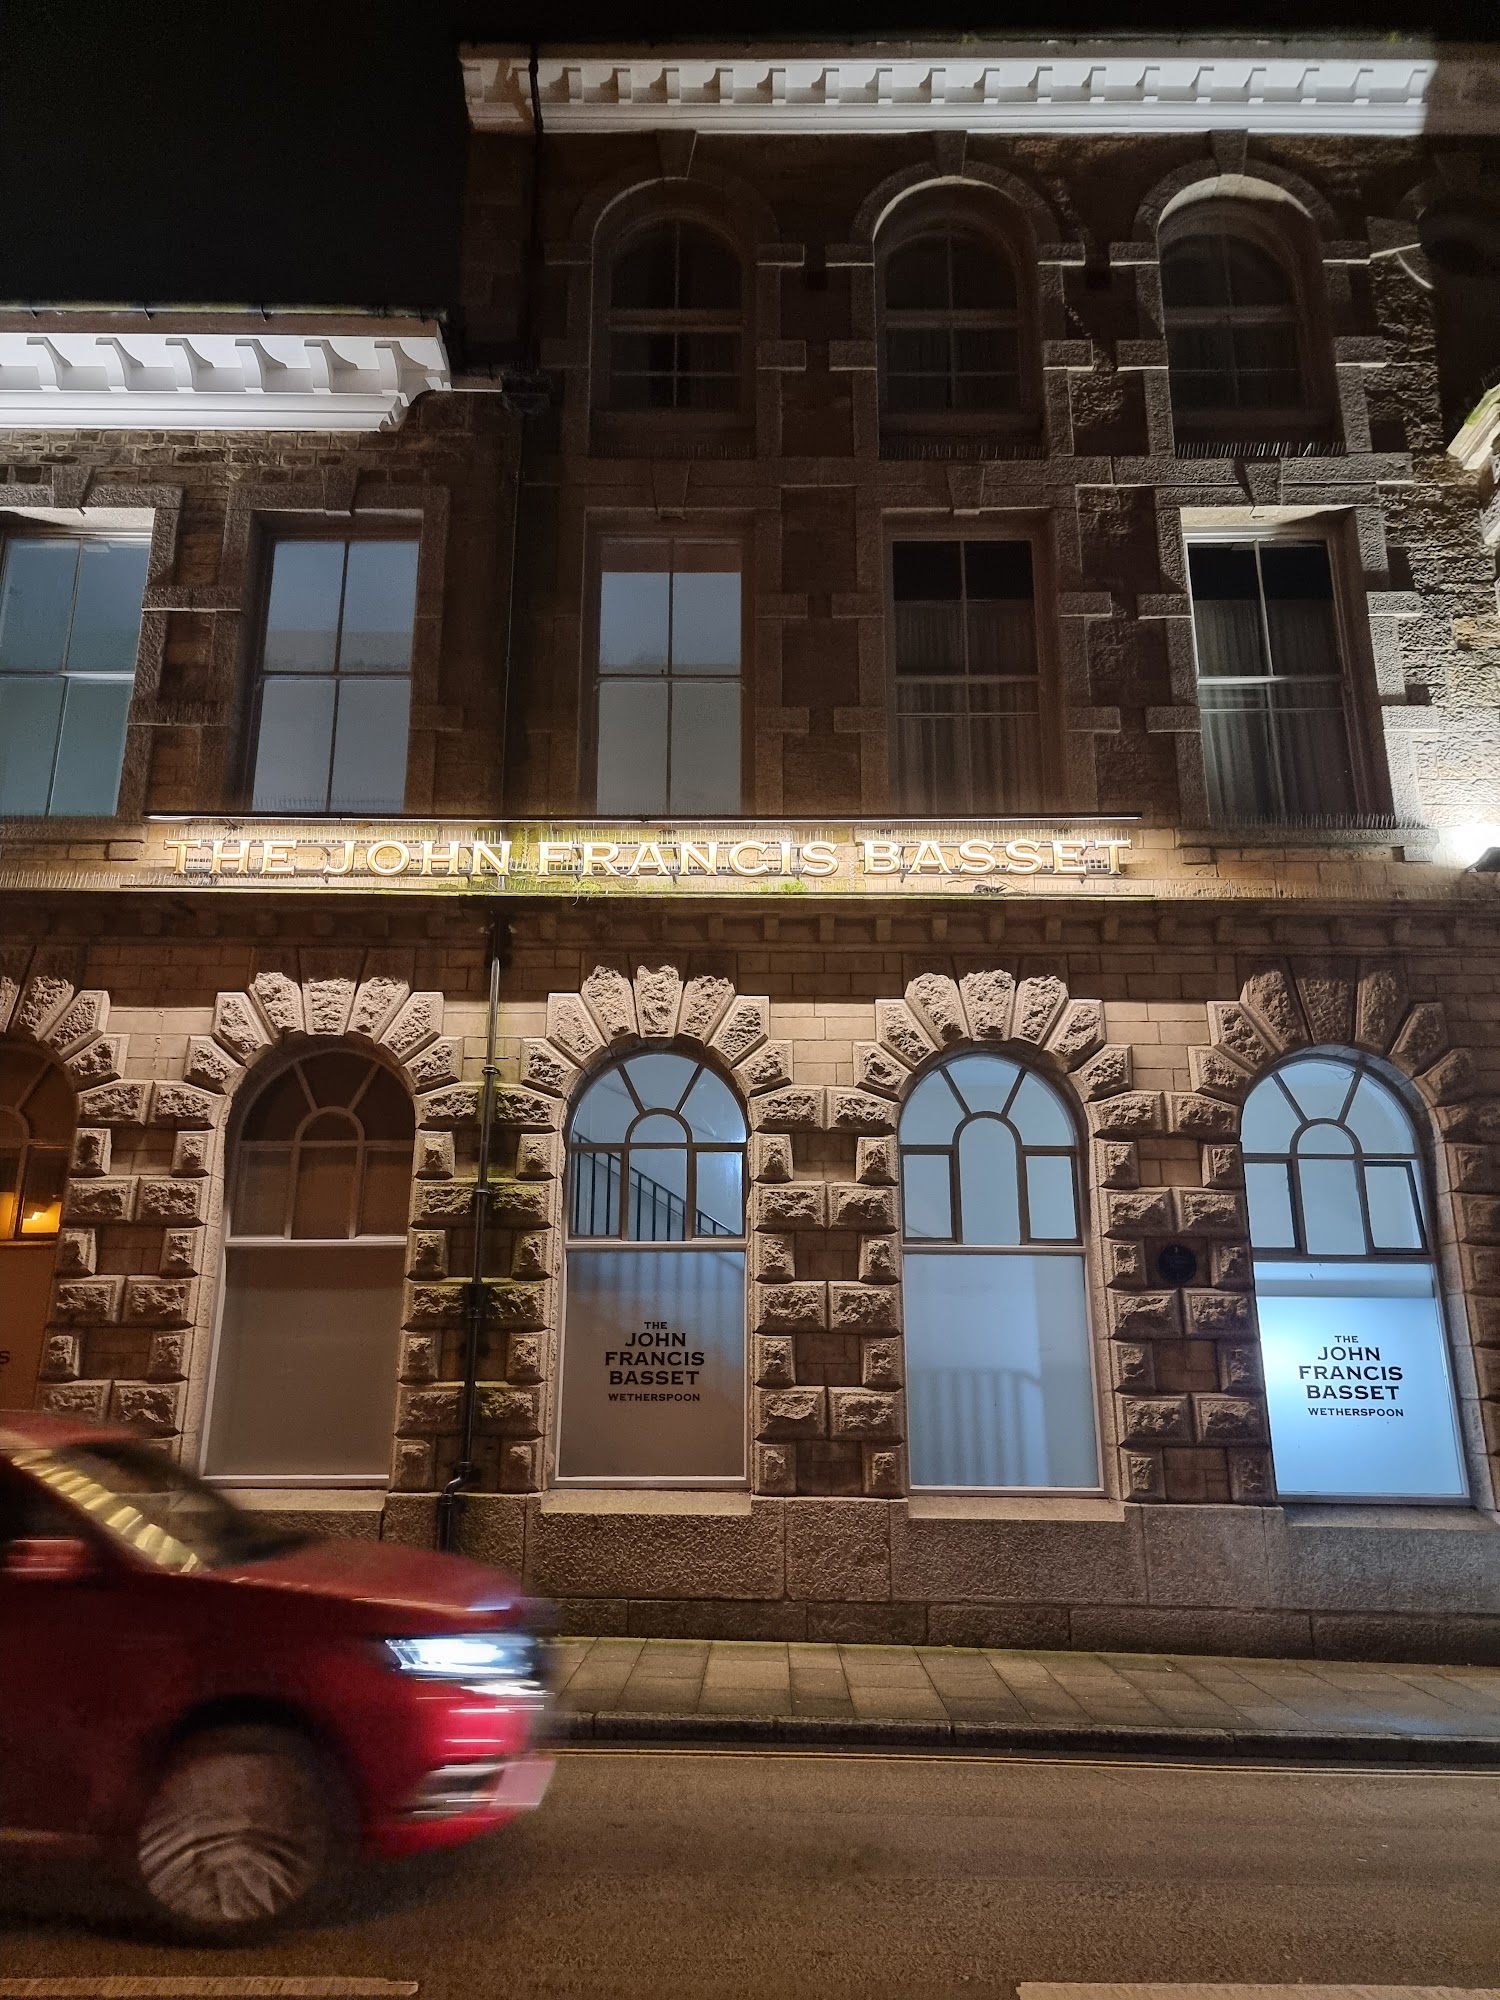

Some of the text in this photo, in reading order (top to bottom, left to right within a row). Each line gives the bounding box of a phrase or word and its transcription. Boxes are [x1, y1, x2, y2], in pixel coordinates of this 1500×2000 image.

[163, 838, 1132, 876] THE JOHN FRANCIS BASSET
[644, 1321, 667, 1330] THE
[624, 1332, 687, 1347] JOHN
[1334, 1335, 1359, 1343] THE
[604, 1351, 705, 1366] FRANCIS
[1317, 1346, 1381, 1361] JOHN
[609, 1370, 699, 1385] BASSET
[1298, 1365, 1403, 1381] FRANCIS
[608, 1393, 700, 1402] WETHERSPOON
[1306, 1384, 1399, 1400] BASSET
[1307, 1407, 1404, 1417] WETHERSPOON
